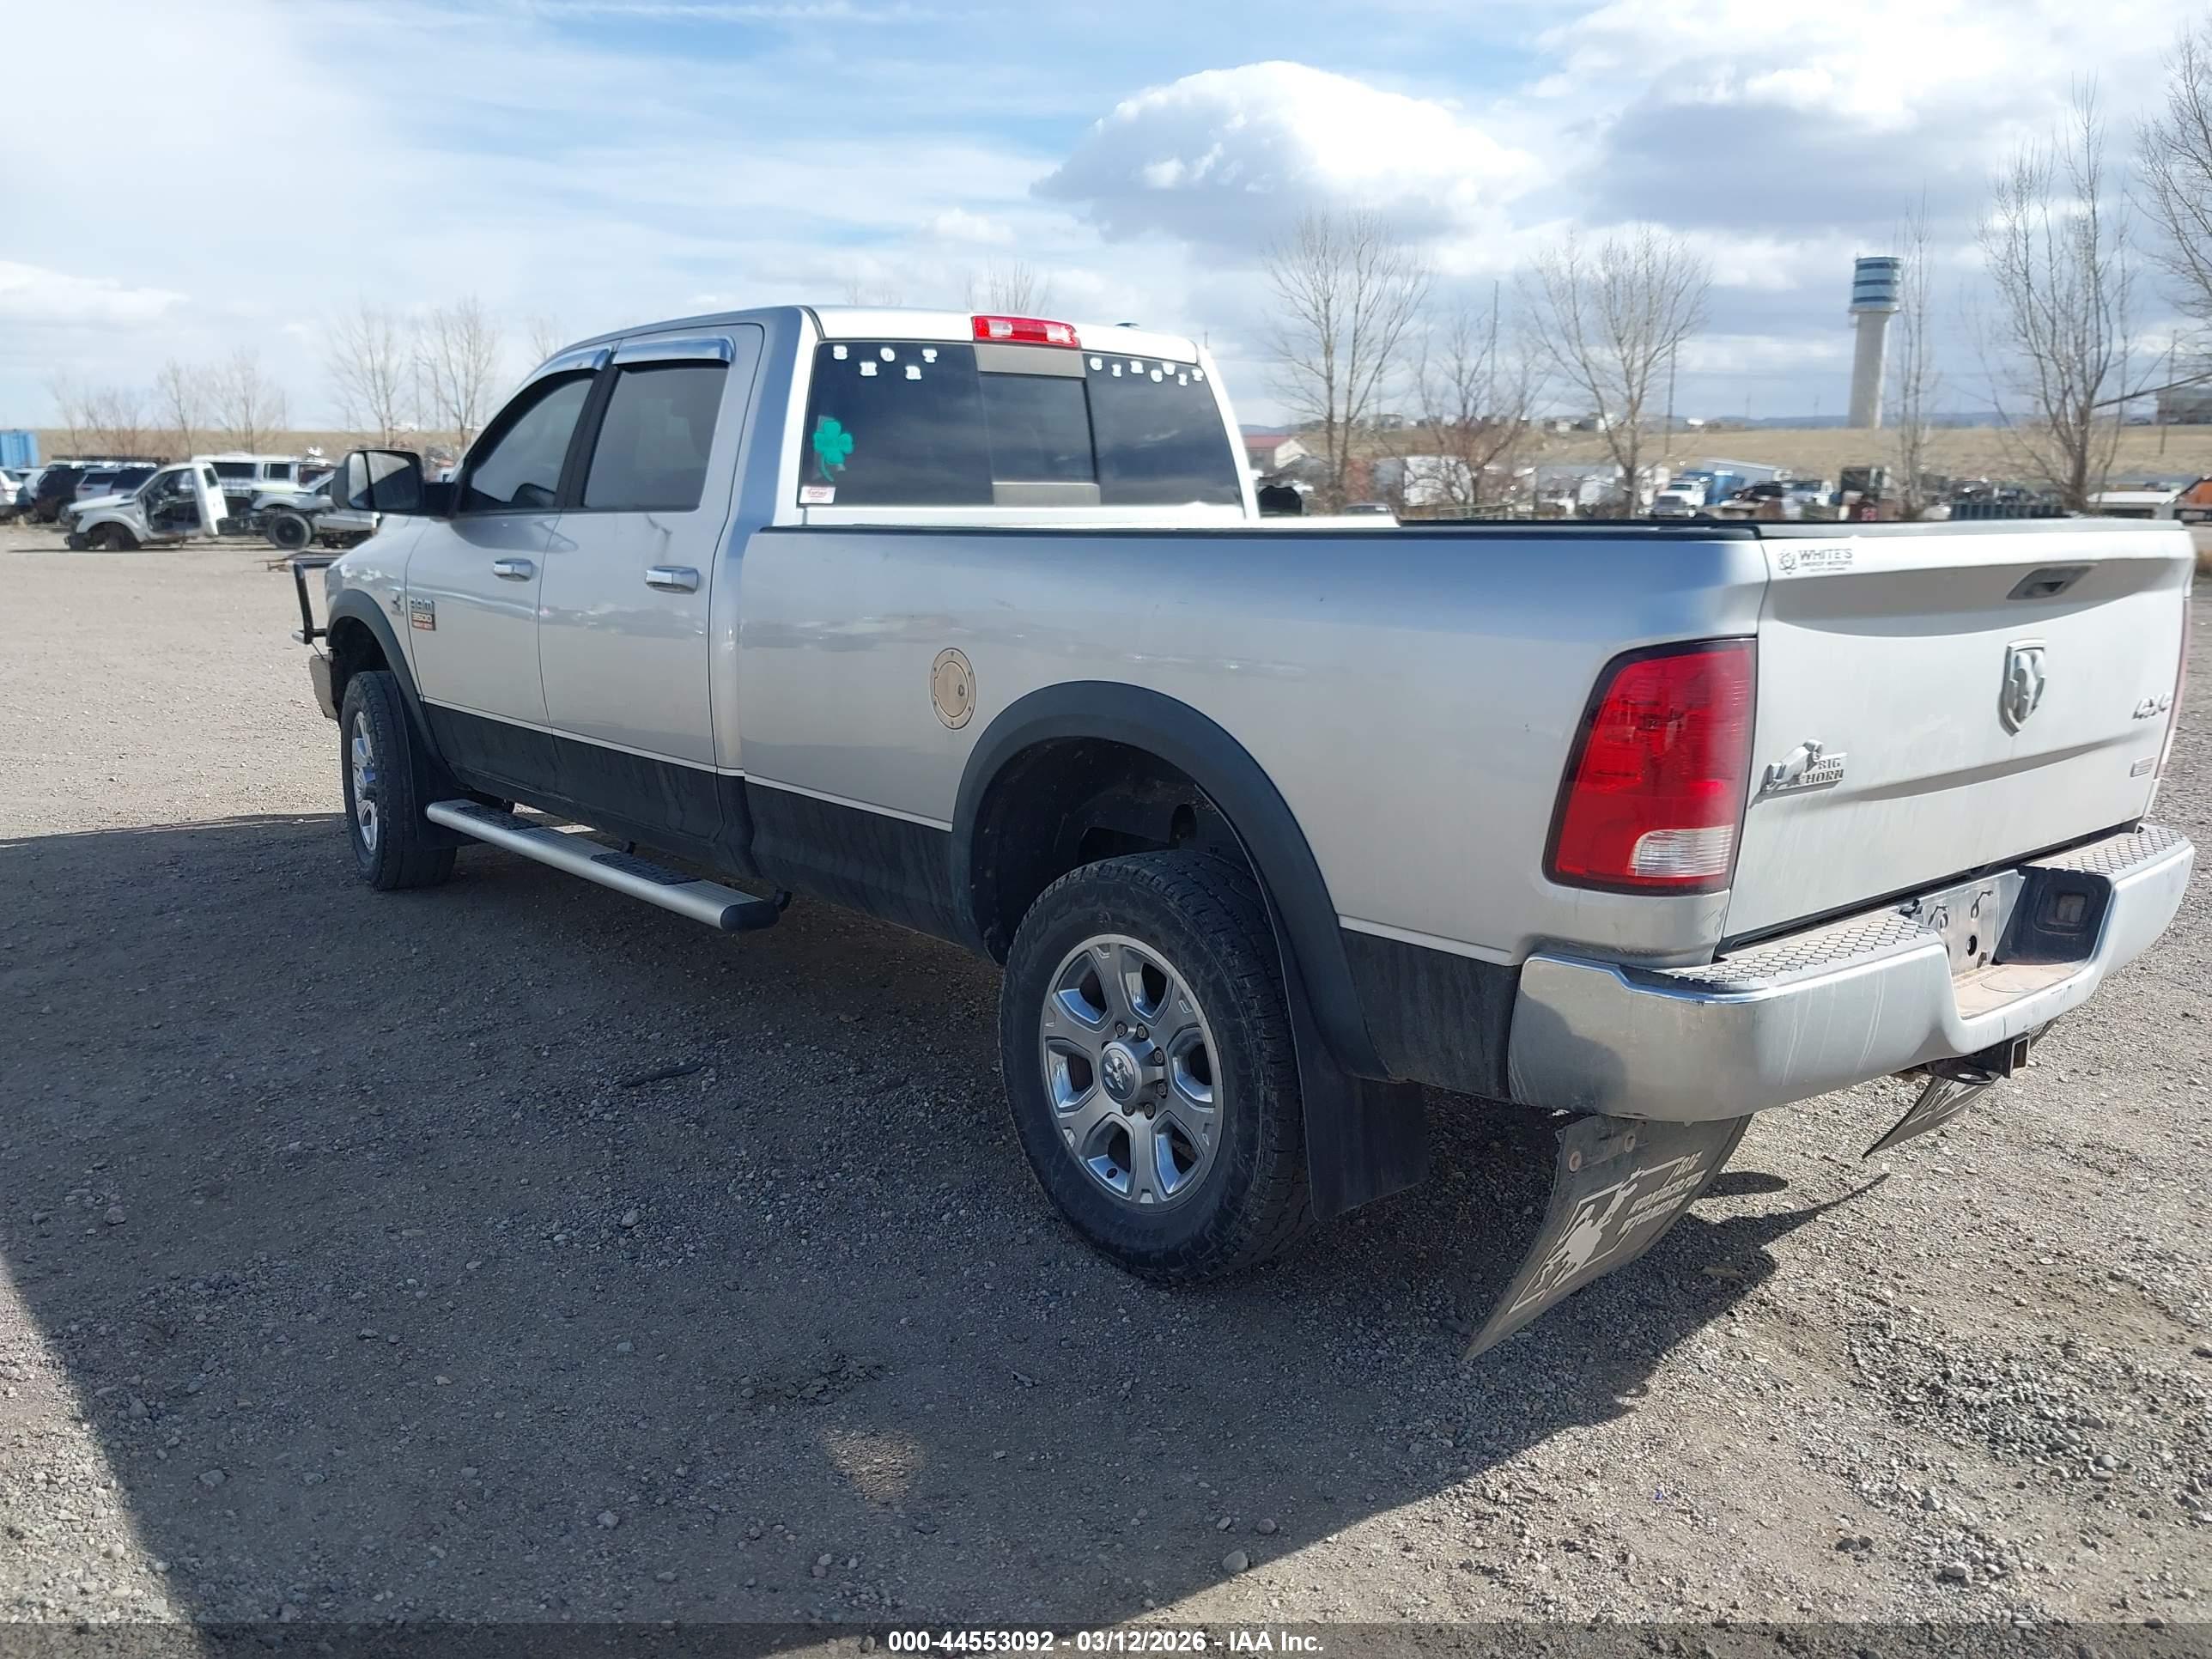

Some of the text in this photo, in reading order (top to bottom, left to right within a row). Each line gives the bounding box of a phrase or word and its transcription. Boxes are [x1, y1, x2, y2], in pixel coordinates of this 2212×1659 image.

[1089, 357, 1204, 386] CIRCUIT
[1818, 757, 1841, 770] BIG
[1805, 769, 1844, 784] HORN
